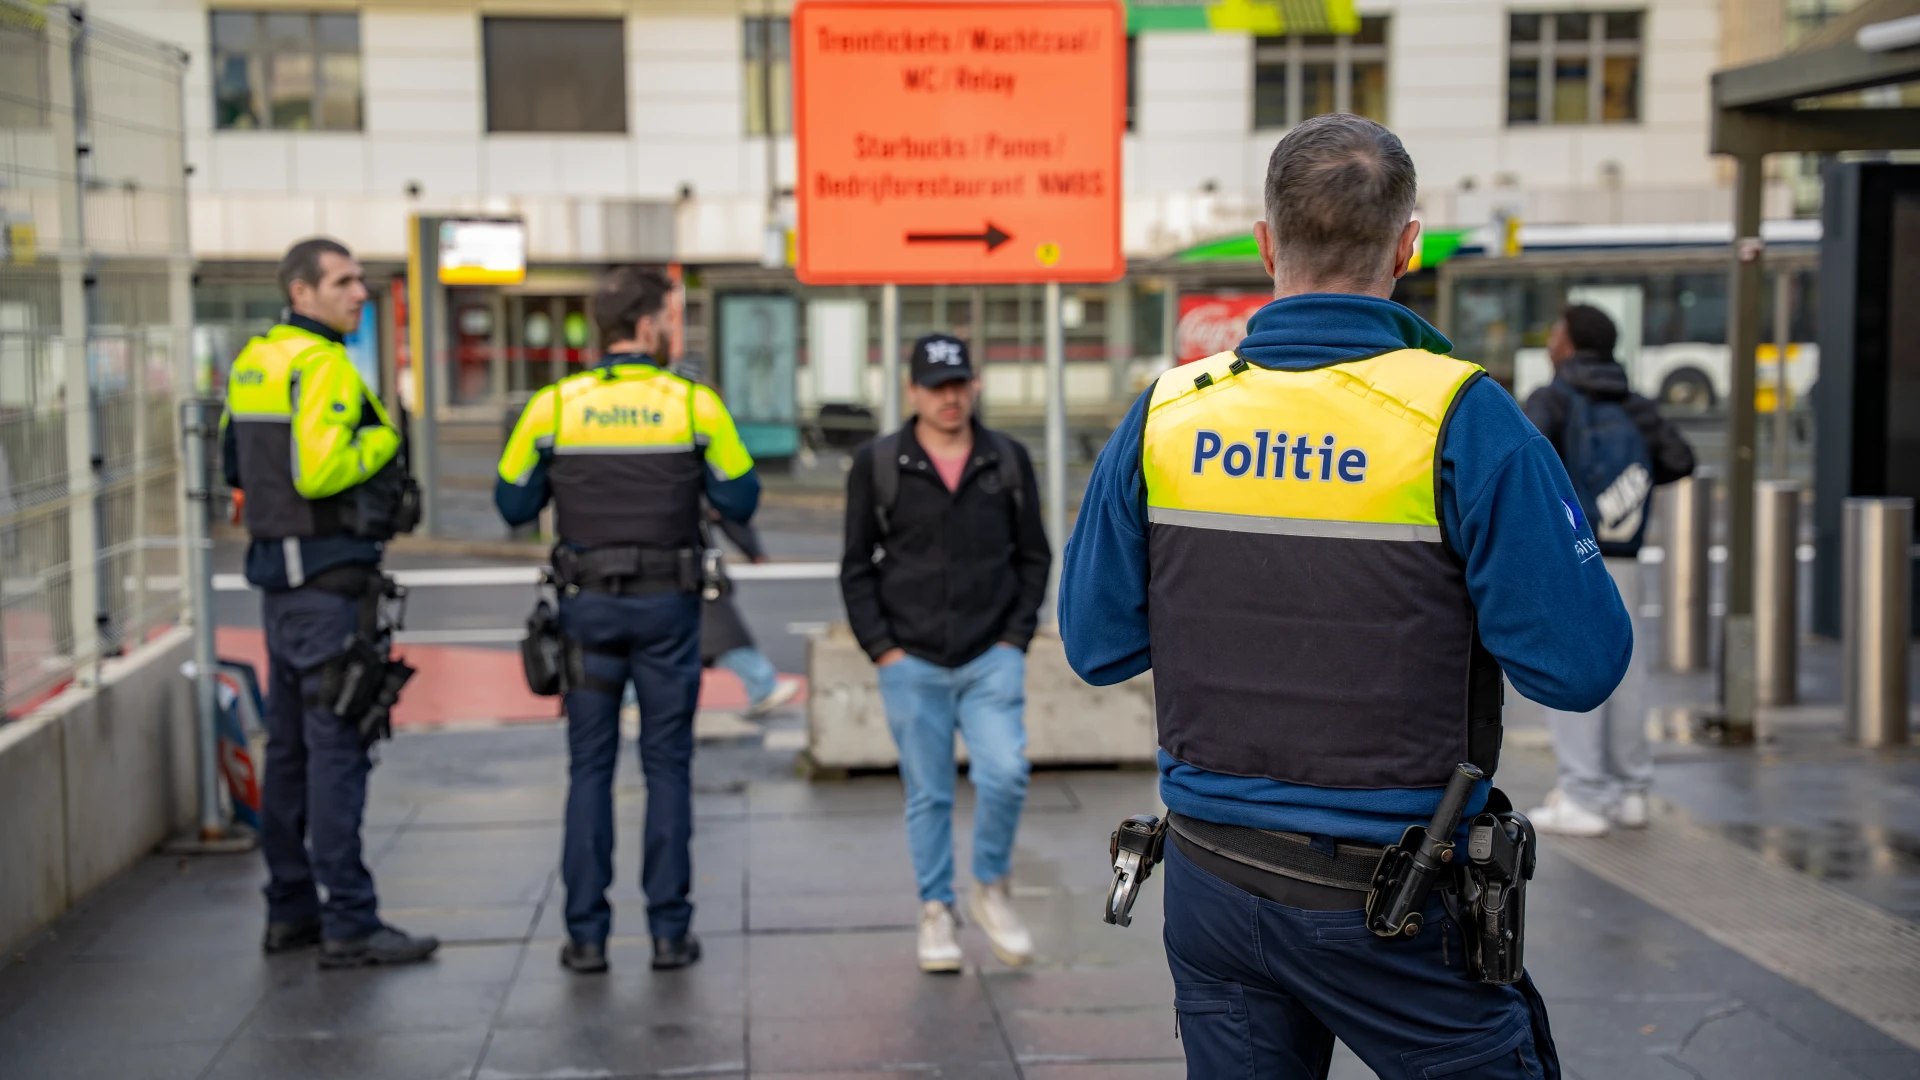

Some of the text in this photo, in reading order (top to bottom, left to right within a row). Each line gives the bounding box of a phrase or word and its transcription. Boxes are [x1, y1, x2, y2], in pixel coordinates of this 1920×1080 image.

[817, 26, 951, 55] Treintickets
[970, 26, 1085, 54] Wachtzaal
[902, 67, 938, 93] WC
[956, 66, 1016, 99] Relay
[854, 131, 966, 160] Starbucks
[984, 131, 1052, 160] Panos
[815, 169, 1023, 206] Bedrijfsrestaurant
[583, 405, 664, 427] Politie
[1191, 429, 1368, 484] Politie
